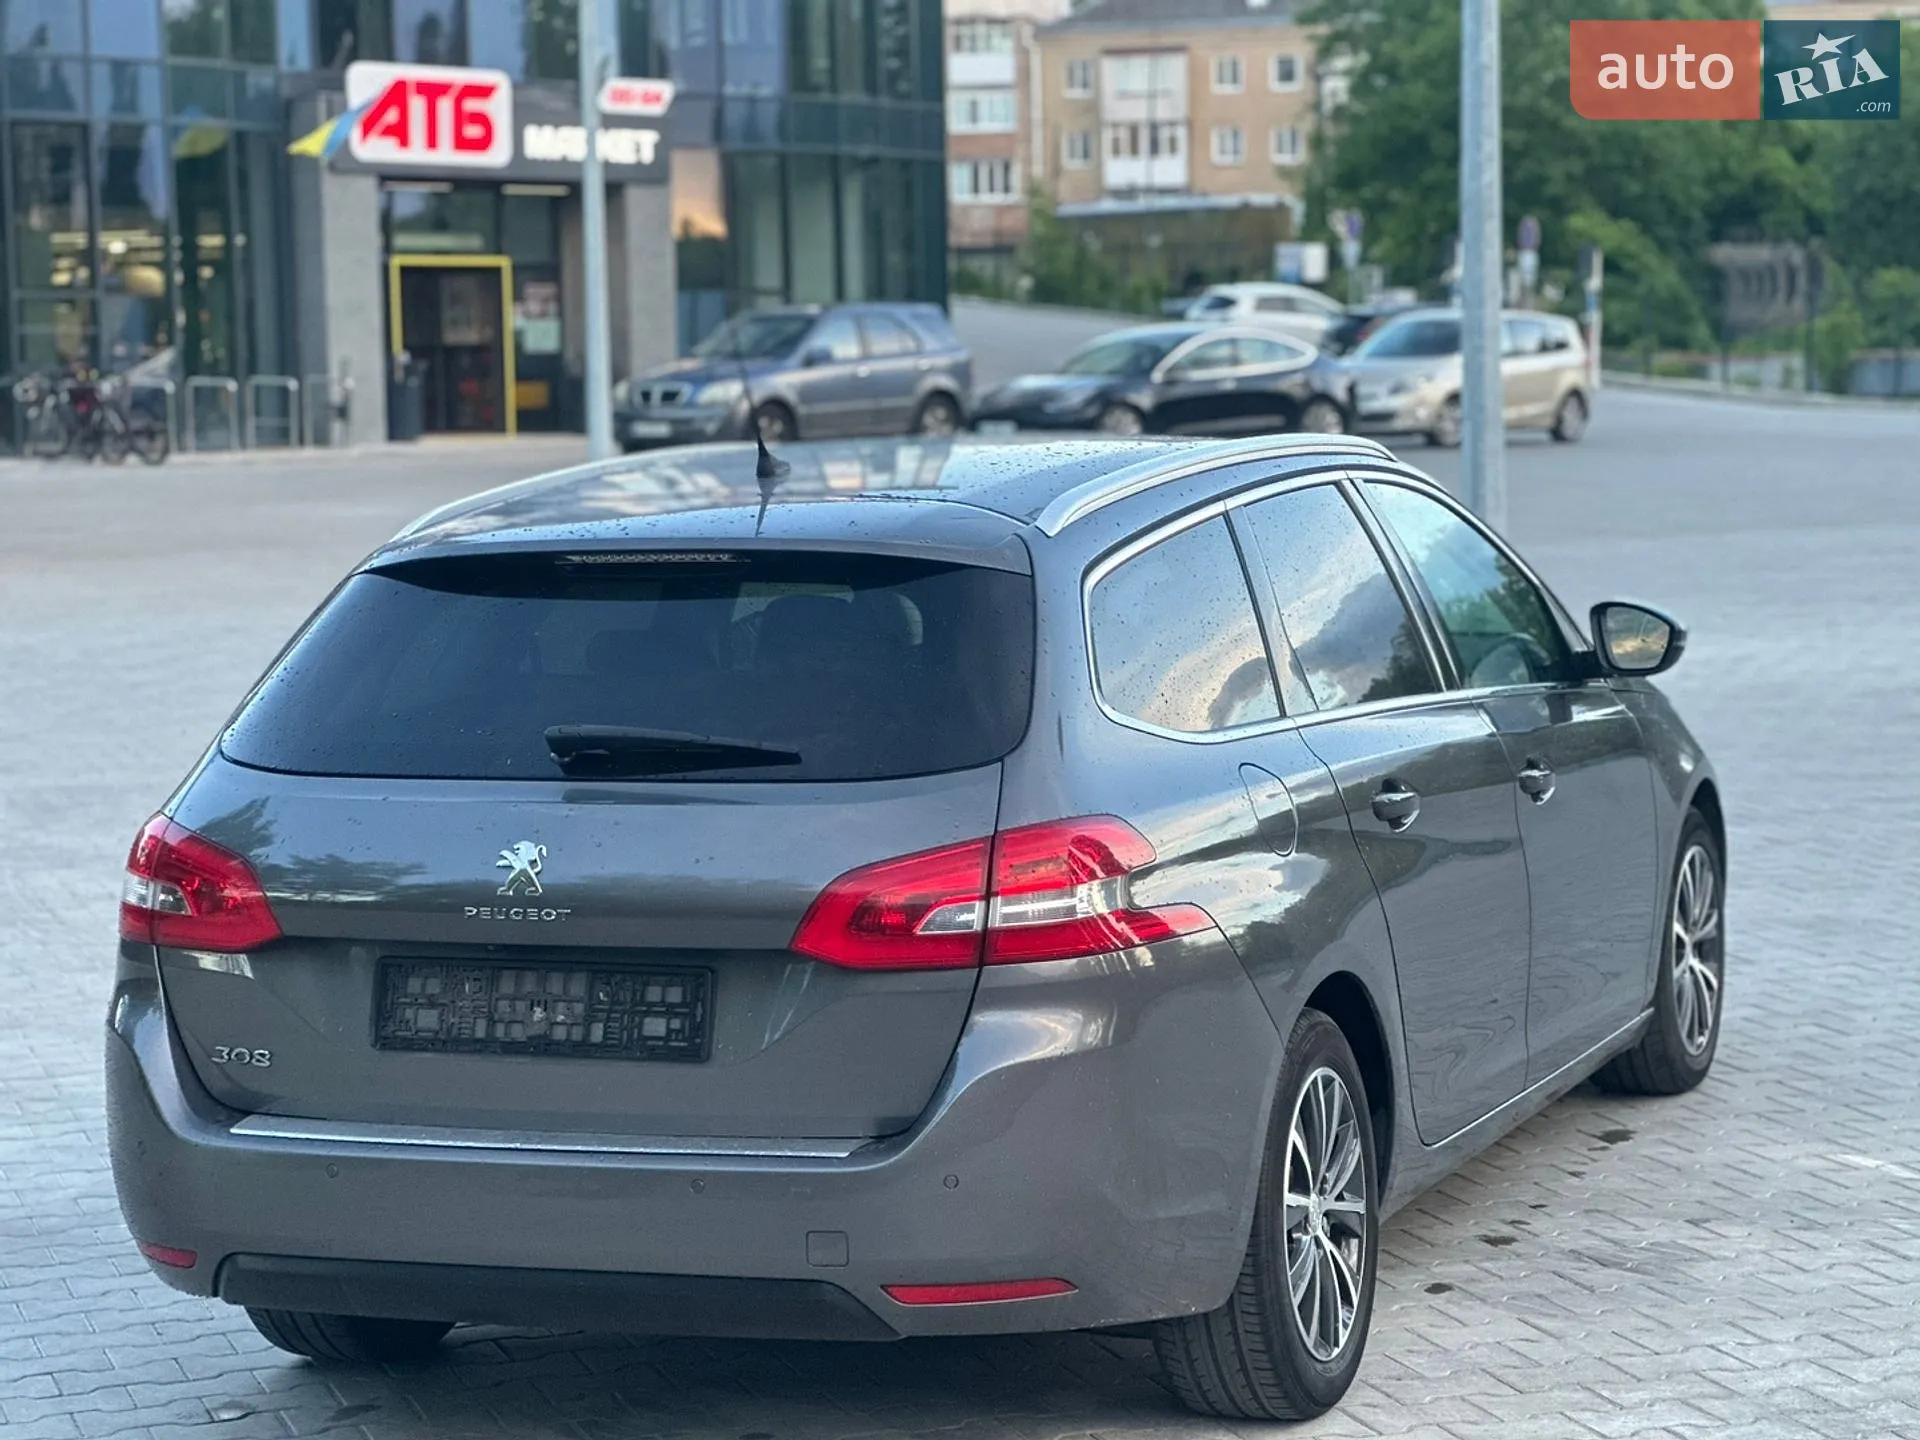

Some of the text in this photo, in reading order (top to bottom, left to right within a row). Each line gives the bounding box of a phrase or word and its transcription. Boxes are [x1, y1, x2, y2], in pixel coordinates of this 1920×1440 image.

[361, 79, 497, 152] АТБ
[463, 906, 572, 921] PEUGEOT
[211, 1046, 271, 1068] 308
